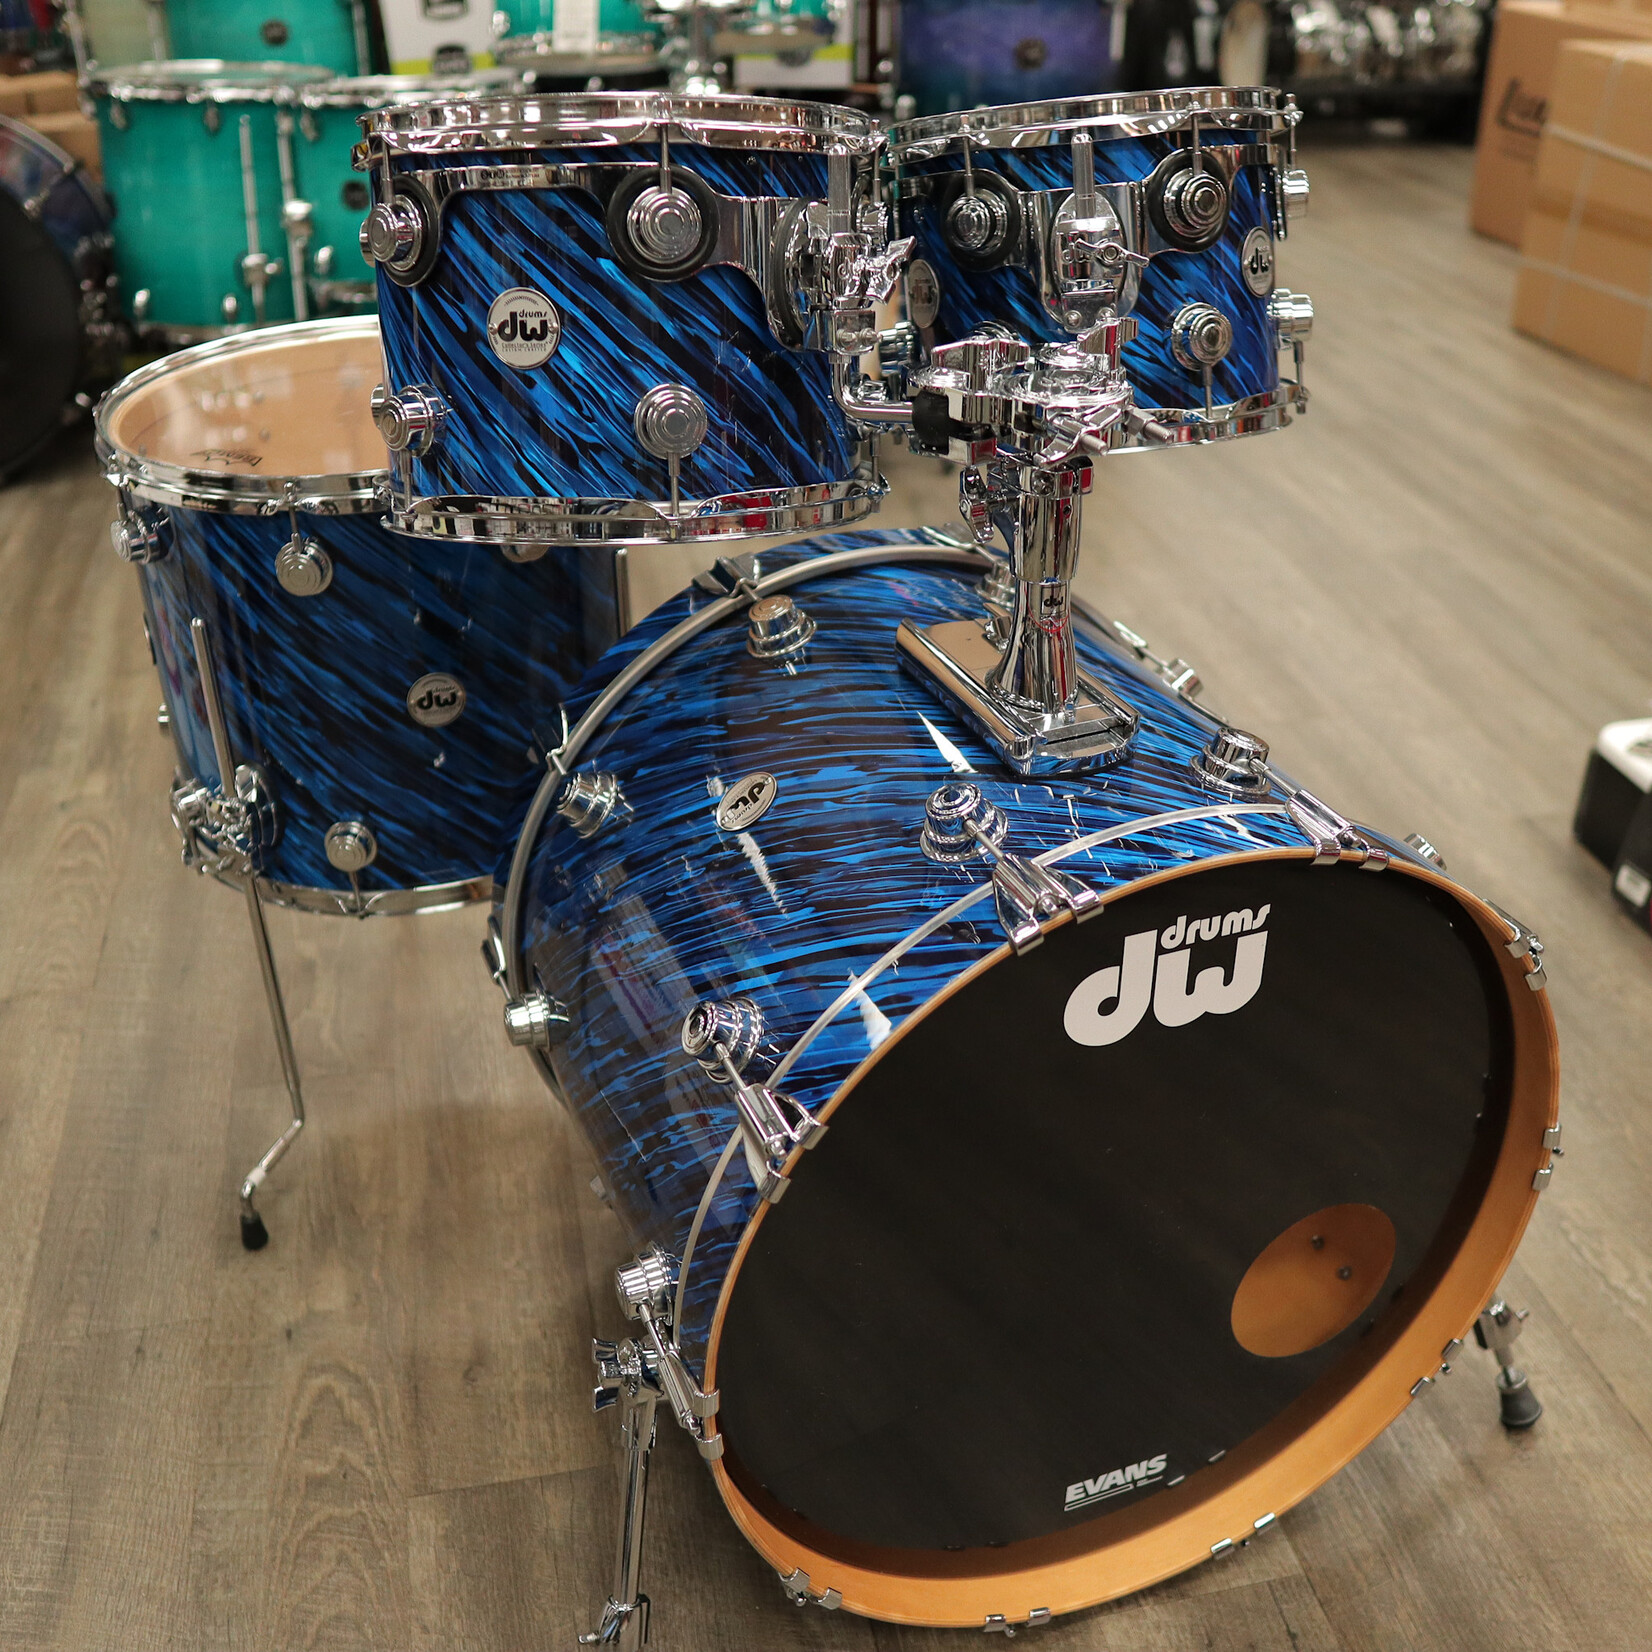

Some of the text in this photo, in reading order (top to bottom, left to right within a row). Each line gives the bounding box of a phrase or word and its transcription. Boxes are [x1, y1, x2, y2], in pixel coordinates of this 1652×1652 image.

[498, 311, 548, 341] dw
[519, 309, 547, 318] drums
[417, 689, 457, 710] dw
[1160, 903, 1271, 950] drums
[1063, 929, 1268, 1047] dw
[1065, 1453, 1167, 1503] EVANS
